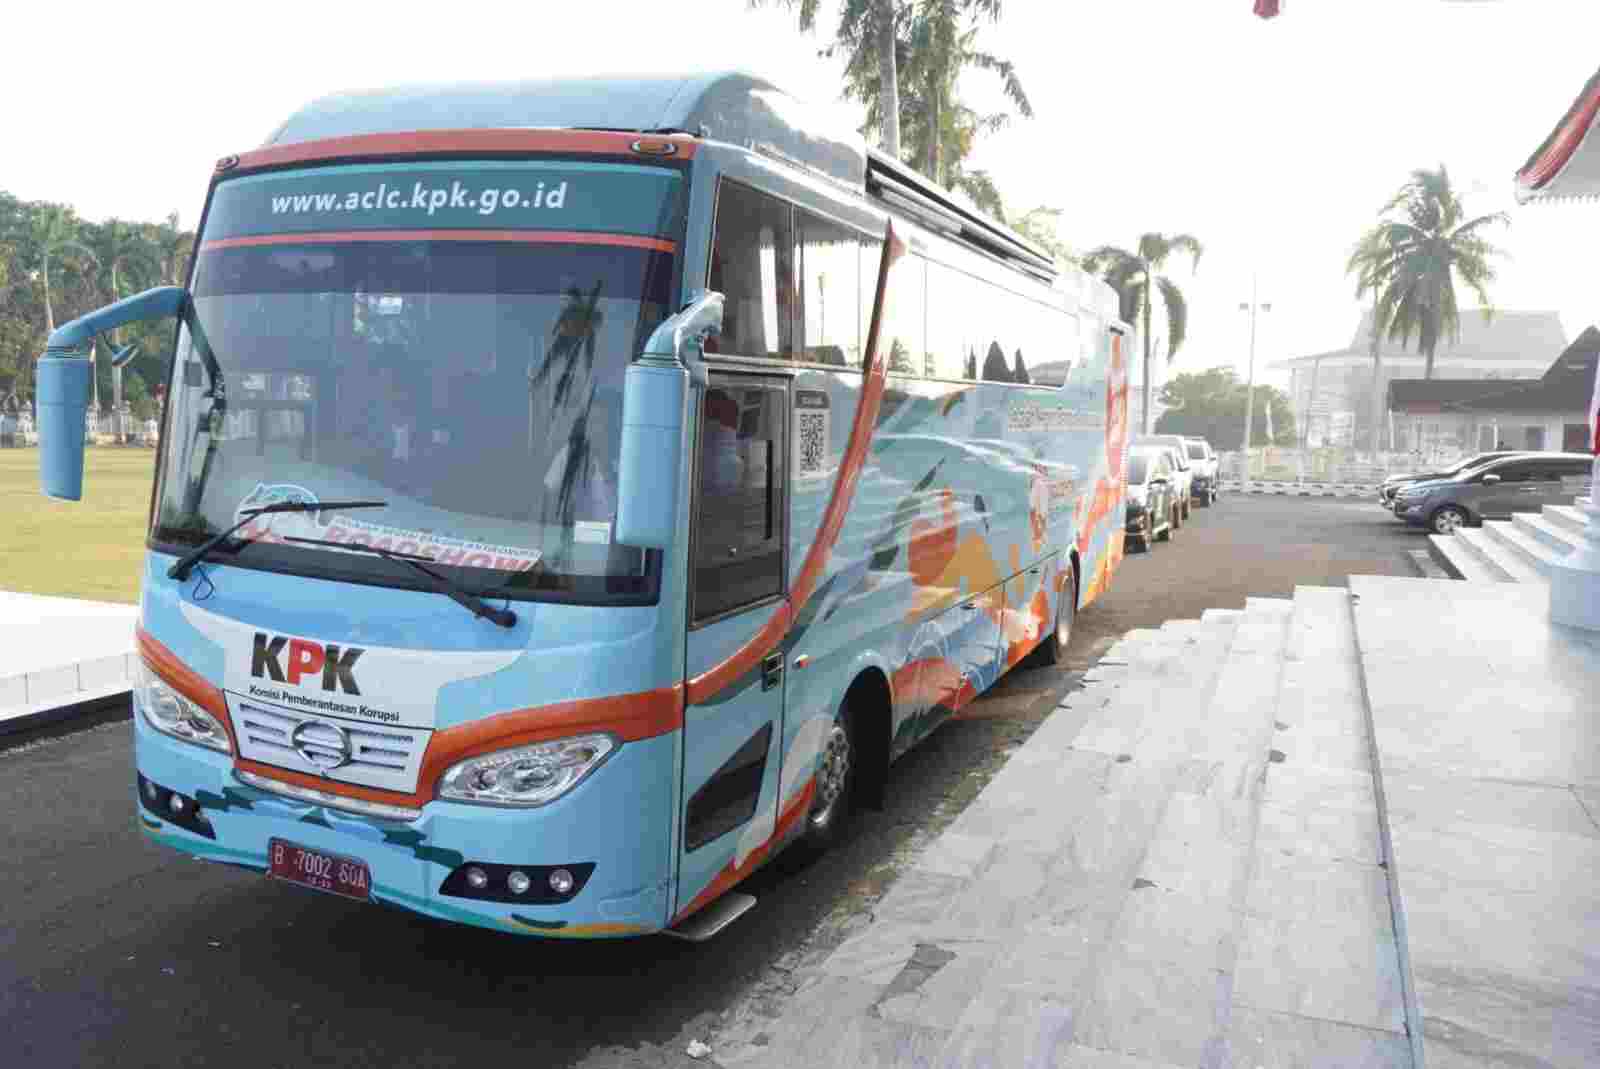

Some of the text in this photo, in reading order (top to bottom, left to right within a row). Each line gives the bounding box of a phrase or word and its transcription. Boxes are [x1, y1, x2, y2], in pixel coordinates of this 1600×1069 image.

[271, 181, 568, 215] www.aclc.kpk.go.id
[251, 632, 366, 696] KPK
[249, 684, 400, 722] Komisi Pemberantasan Korupsi
[274, 844, 284, 865] B
[296, 850, 332, 879] 7002
